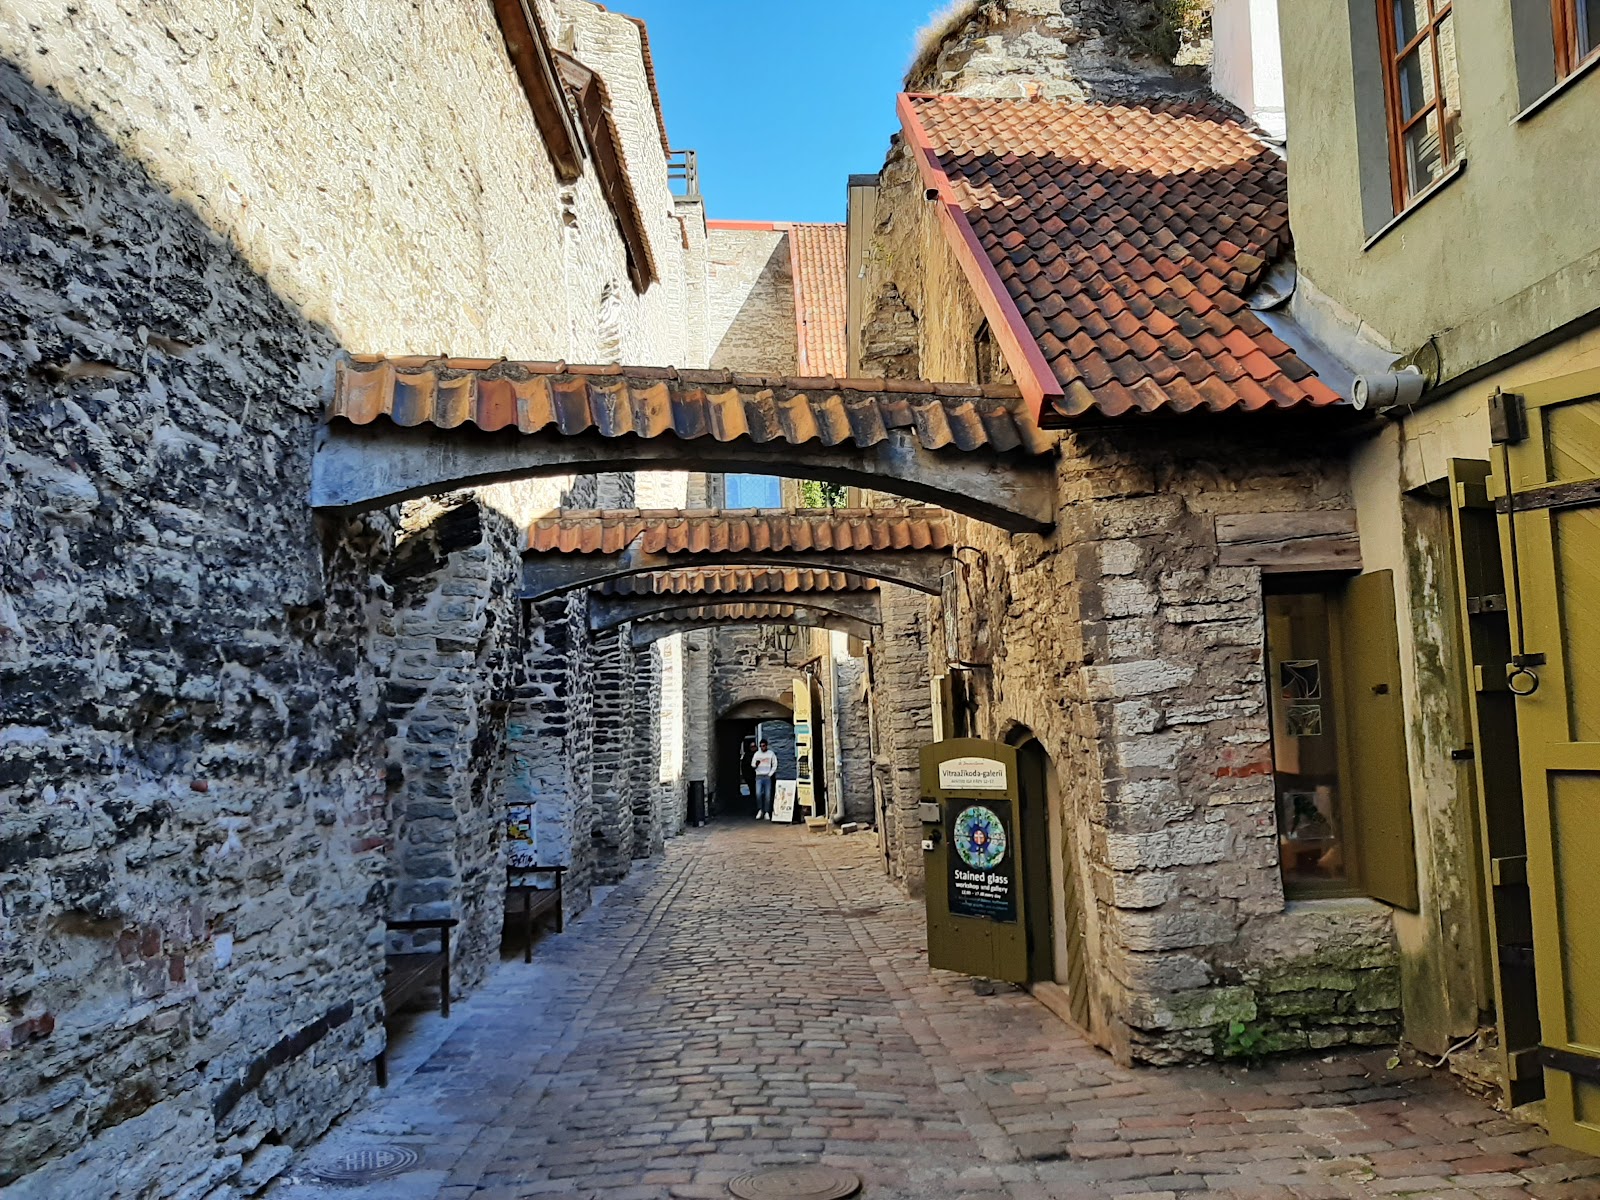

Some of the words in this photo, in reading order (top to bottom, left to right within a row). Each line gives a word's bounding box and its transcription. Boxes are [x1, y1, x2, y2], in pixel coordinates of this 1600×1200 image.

[954, 870, 985, 882] Stained
[988, 873, 1008, 884] glass
[956, 882, 980, 890] workshop
[990, 886, 1008, 894] gallery
